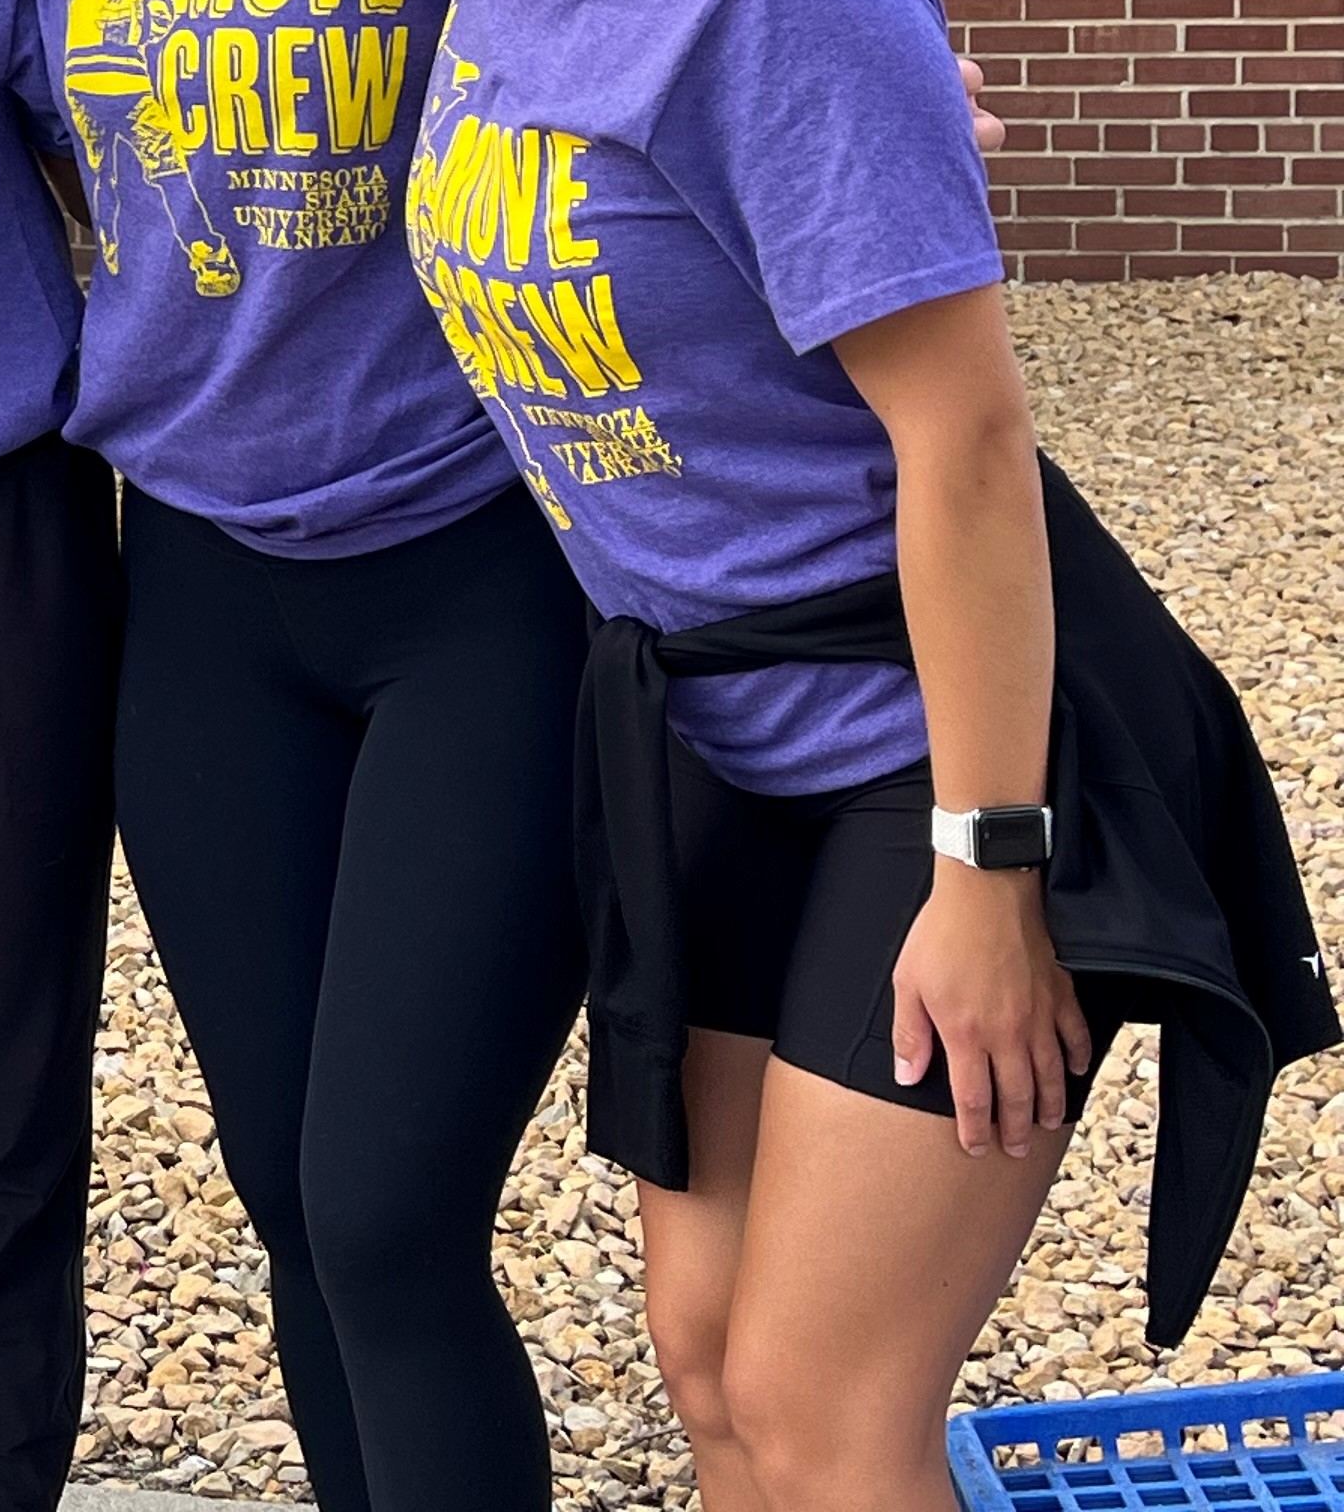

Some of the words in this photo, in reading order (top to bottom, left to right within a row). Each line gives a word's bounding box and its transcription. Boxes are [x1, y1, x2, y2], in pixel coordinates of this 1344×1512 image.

[157, 26, 409, 155] CREW
[226, 164, 388, 192] MINNESOTA
[305, 185, 389, 211] STATE
[433, 114, 599, 271] MOVE
[434, 257, 642, 398] CREW
